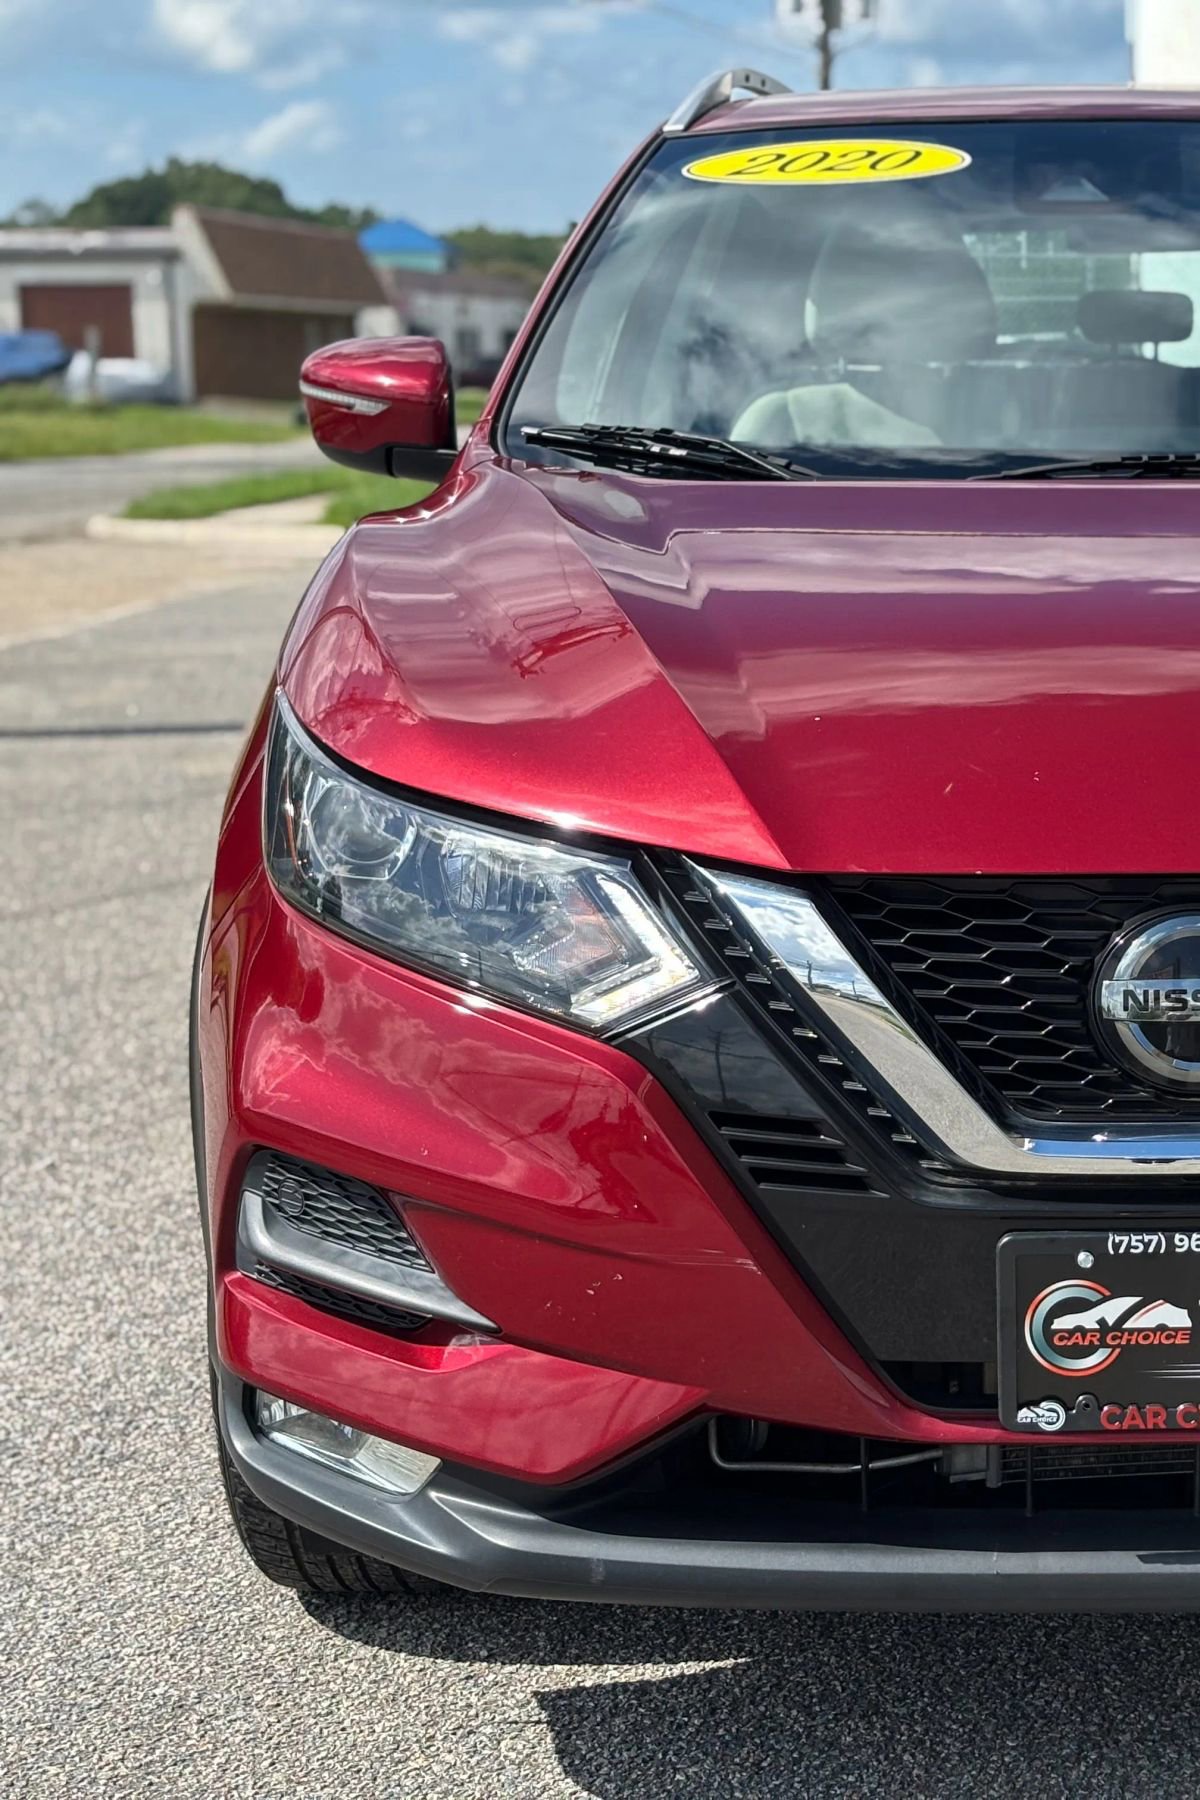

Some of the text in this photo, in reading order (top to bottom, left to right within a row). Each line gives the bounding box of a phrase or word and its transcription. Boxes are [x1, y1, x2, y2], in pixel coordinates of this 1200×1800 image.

[726, 149, 923, 176] 2020
[1107, 1232, 1166, 1254] (757)
[1053, 1330, 1192, 1346] CAR CHOICE
[1100, 1403, 1167, 1430] CAR
